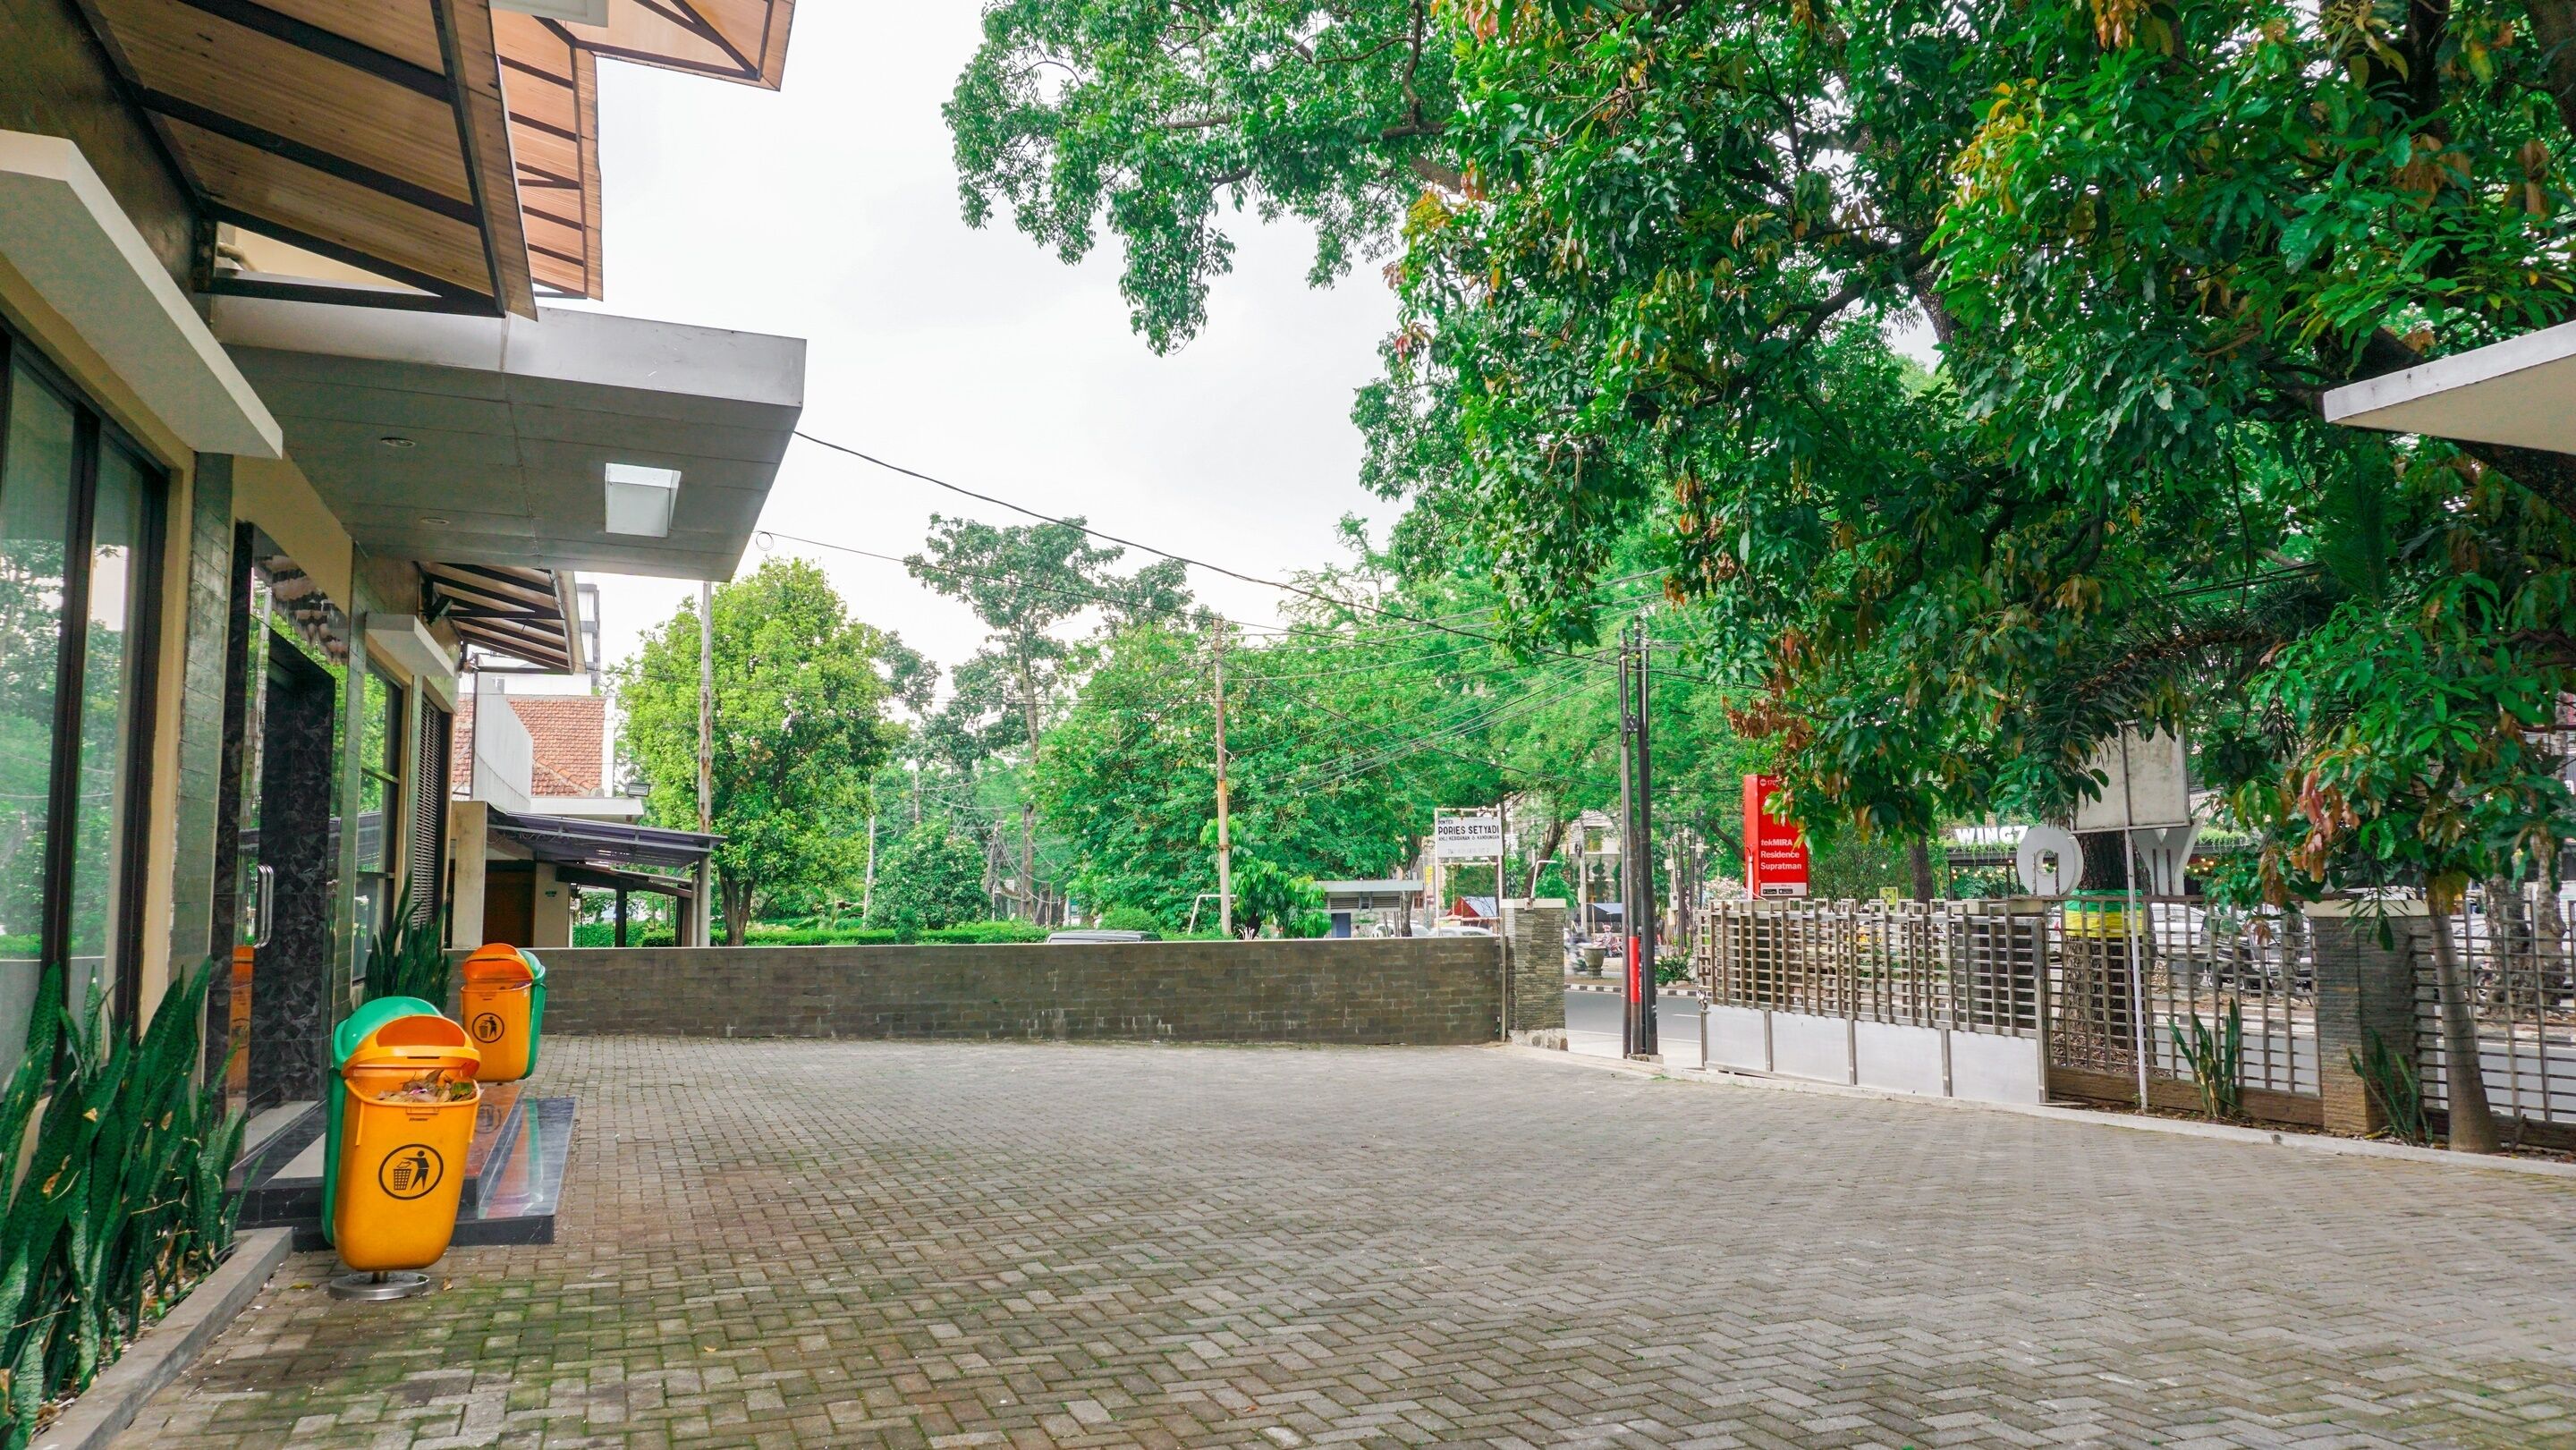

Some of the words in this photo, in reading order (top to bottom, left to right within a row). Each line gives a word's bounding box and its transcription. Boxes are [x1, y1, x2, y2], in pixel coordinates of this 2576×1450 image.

[1437, 826, 1466, 835] PORIES
[1468, 825, 1500, 835] SETYADI
[1760, 838, 1793, 846] tekMIRA
[1760, 851, 1801, 859] Residence
[1760, 862, 1802, 871] Supratman
